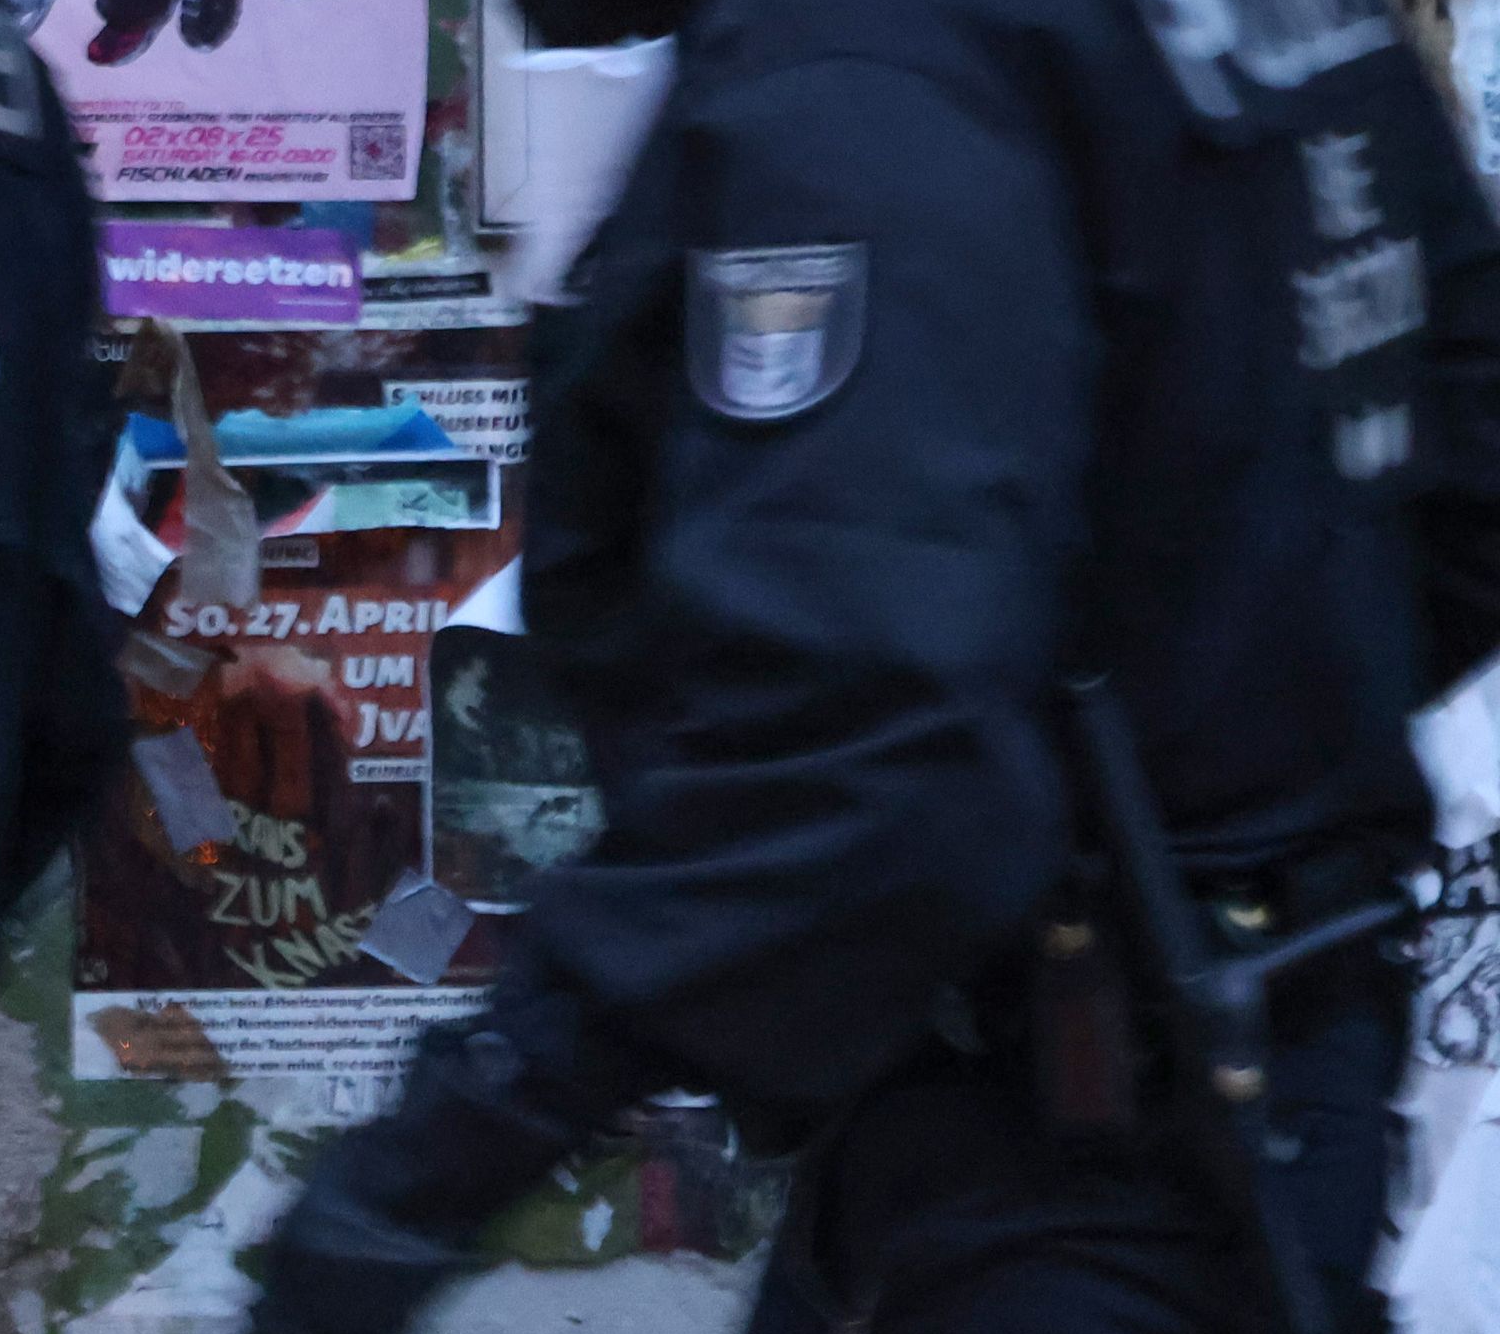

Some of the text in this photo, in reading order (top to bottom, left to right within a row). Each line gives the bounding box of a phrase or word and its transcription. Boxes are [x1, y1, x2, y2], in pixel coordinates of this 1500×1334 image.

[106, 245, 354, 288] widersetzen
[392, 388, 486, 406] SHLUSS
[245, 601, 311, 640] 27.
[343, 655, 416, 689] UM
[209, 869, 328, 927] ZUM
